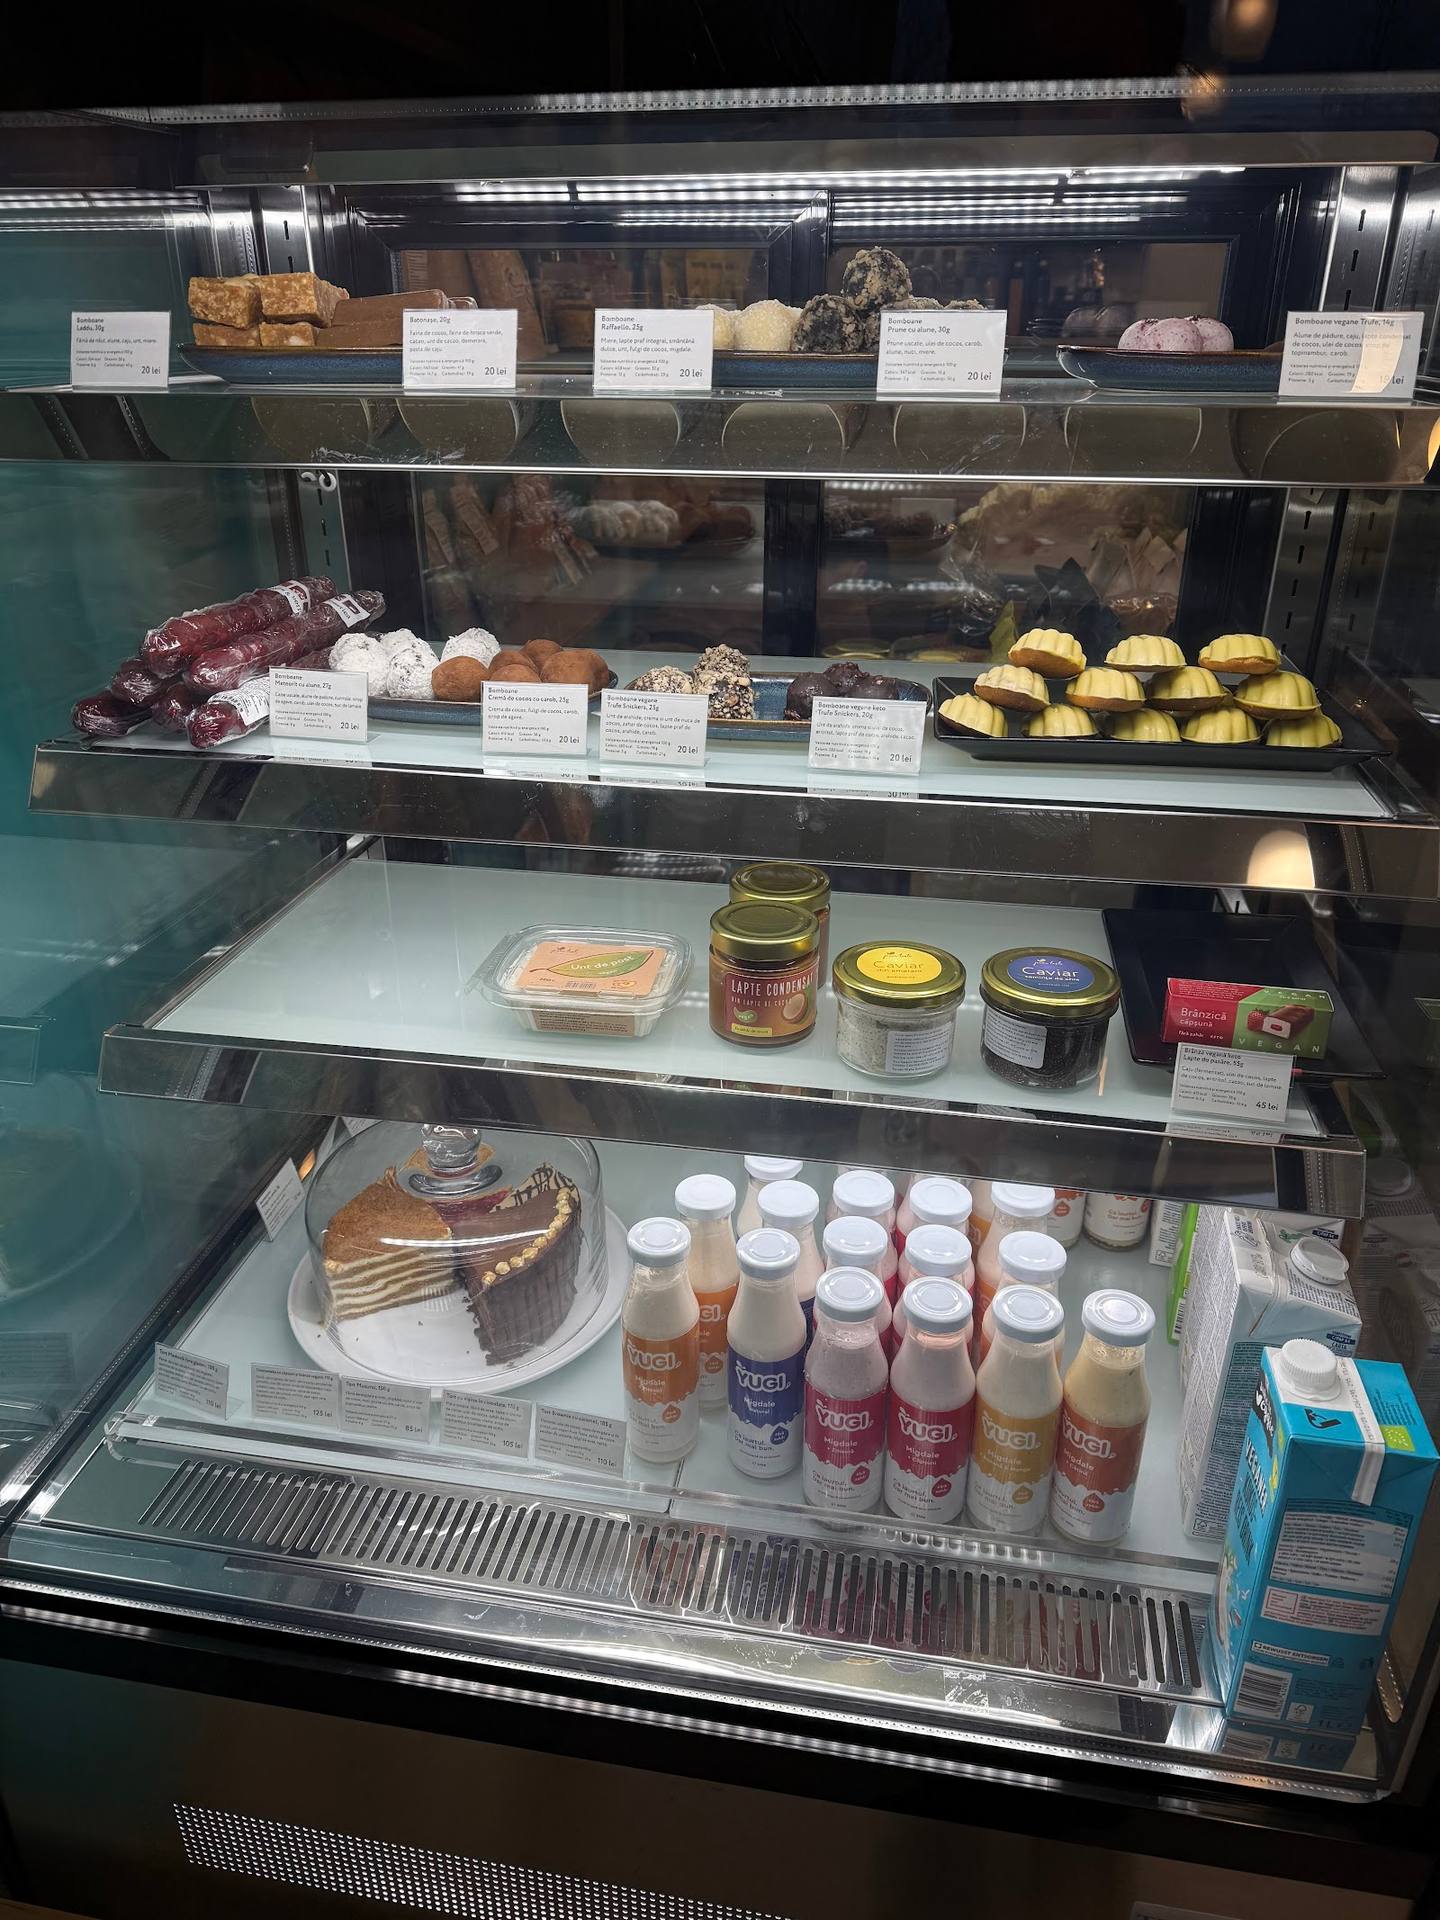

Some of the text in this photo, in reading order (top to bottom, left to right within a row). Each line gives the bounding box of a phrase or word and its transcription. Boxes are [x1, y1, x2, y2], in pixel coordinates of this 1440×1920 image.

[1382, 319, 1395, 327] 14g
[485, 367, 494, 375] 20
[497, 367, 506, 375] lei
[680, 369, 703, 377] 20 lei
[968, 372, 978, 380] 20
[980, 372, 992, 380] lei
[1392, 376, 1404, 384] lei
[610, 955, 633, 966] post
[874, 961, 924, 969] Caviar
[1022, 966, 1080, 977] Caviar
[731, 973, 814, 996] LAPTE CONDENSAT
[1181, 1008, 1227, 1021] Brânzică
[1238, 1038, 1320, 1053] VEGAN
[1268, 1102, 1279, 1111] lei
[700, 1304, 720, 1322] GI
[628, 1345, 677, 1370] YUGI
[736, 1365, 787, 1393] YUGI
[816, 1404, 869, 1431] YUGI
[899, 1412, 952, 1443] YUGI
[982, 1416, 1036, 1450] YUGI
[824, 1436, 858, 1447] Migdale
[1062, 1415, 1111, 1459] YUGI
[906, 1445, 940, 1459] Migdale
[597, 1457, 608, 1465] 110
